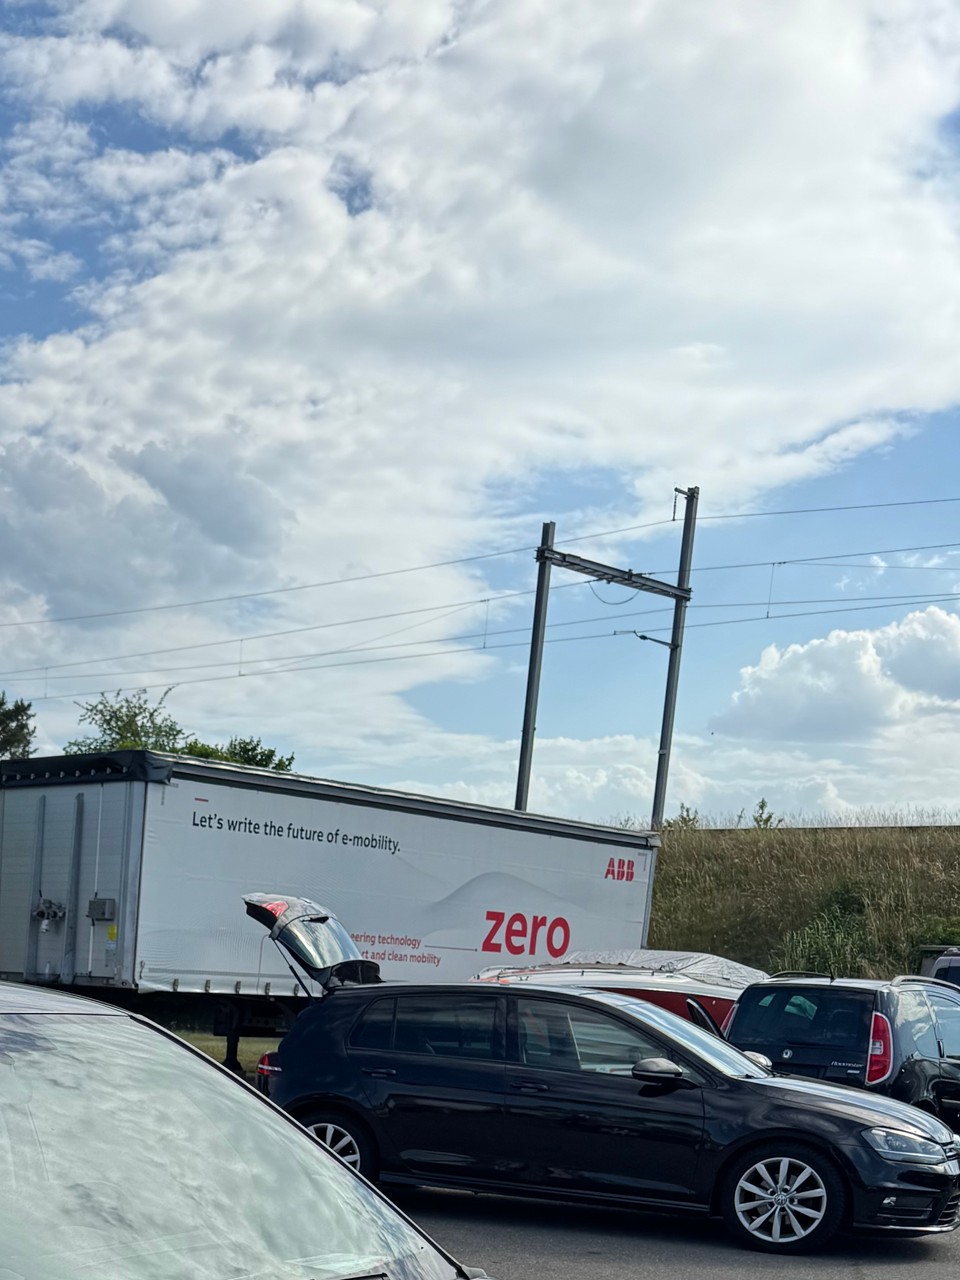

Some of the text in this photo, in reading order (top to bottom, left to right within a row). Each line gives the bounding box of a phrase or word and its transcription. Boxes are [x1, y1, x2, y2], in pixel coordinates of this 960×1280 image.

[192, 811, 401, 855] Let’s write the future of e-mobility.
[605, 857, 635, 882] ABB
[378, 934, 421, 949] technology
[482, 911, 570, 958] zero
[371, 951, 386, 961] and
[387, 951, 408, 962] clean
[410, 953, 441, 967] mobility
